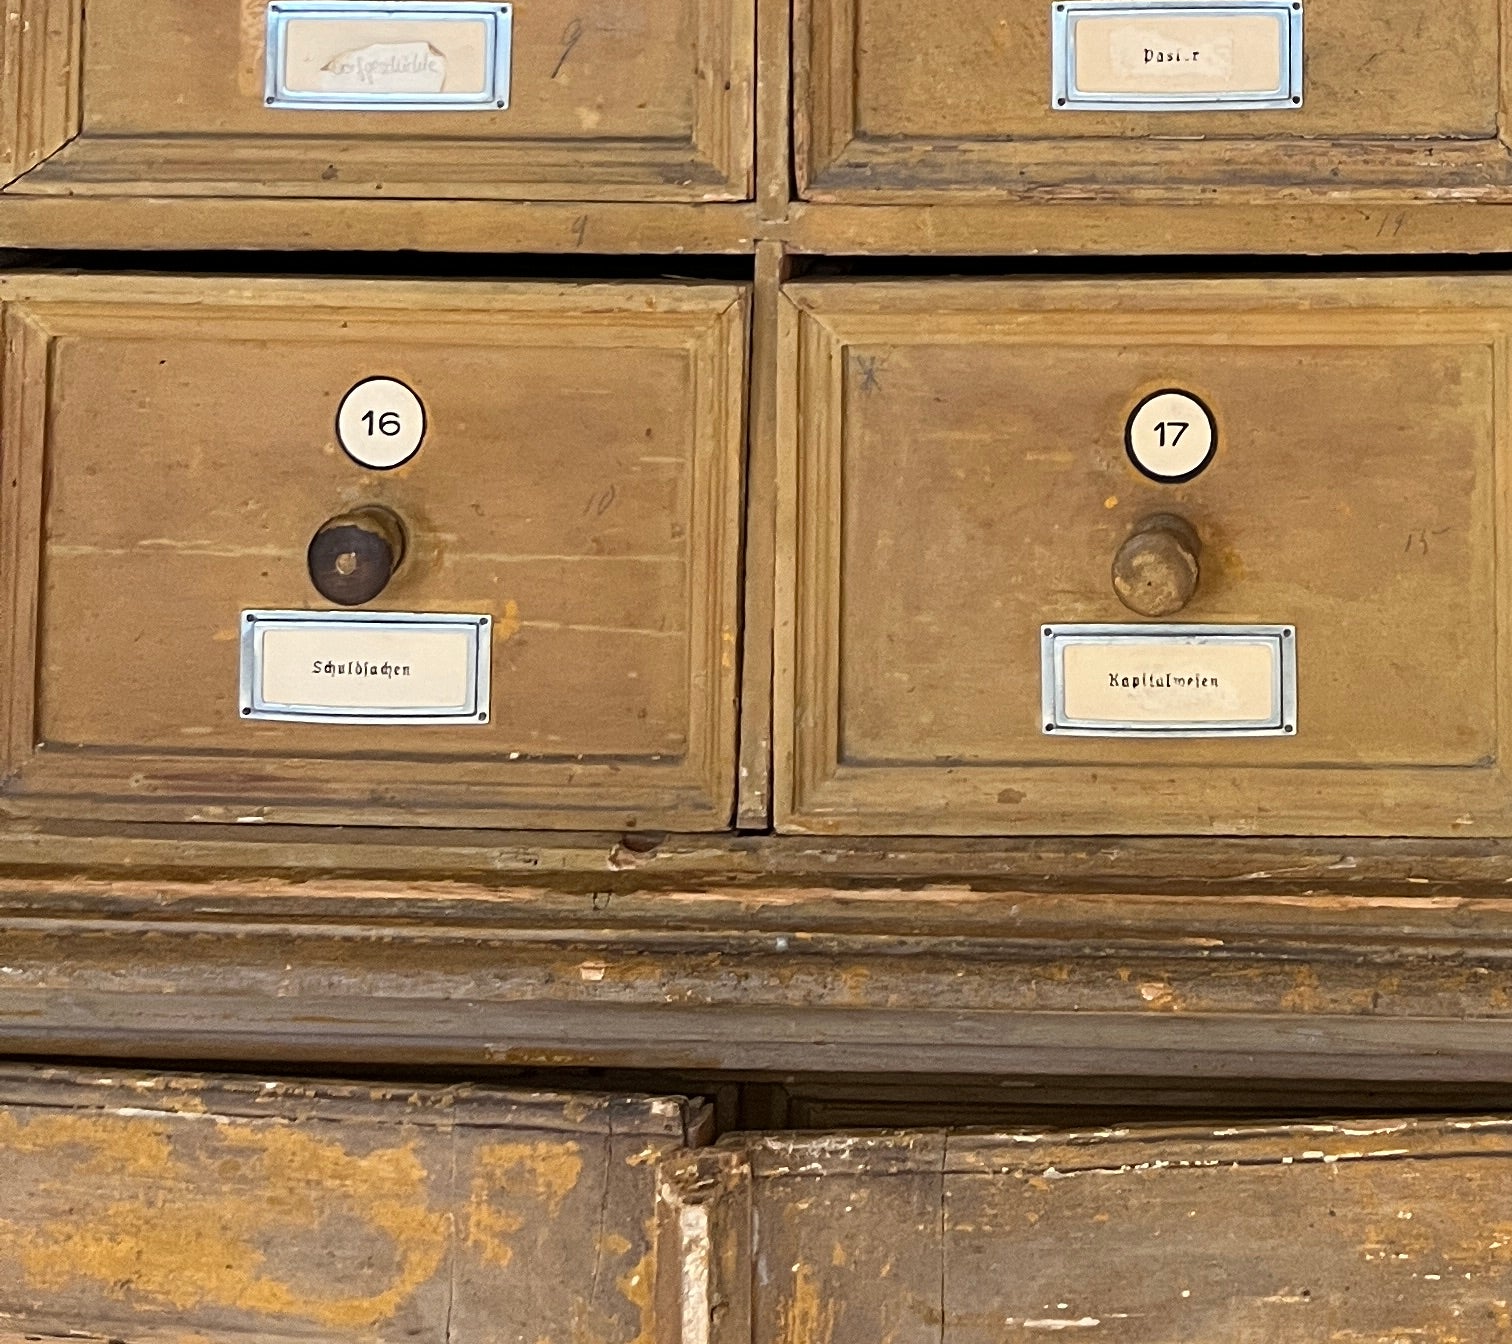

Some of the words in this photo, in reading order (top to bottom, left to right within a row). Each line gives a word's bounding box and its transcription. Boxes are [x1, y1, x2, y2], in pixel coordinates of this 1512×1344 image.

[1143, 48, 1200, 64] Pastr
[361, 410, 401, 437] 16
[1153, 421, 1190, 447] 17
[312, 660, 411, 680] Schuldsachen
[1108, 672, 1219, 689] Kapitalwesen
